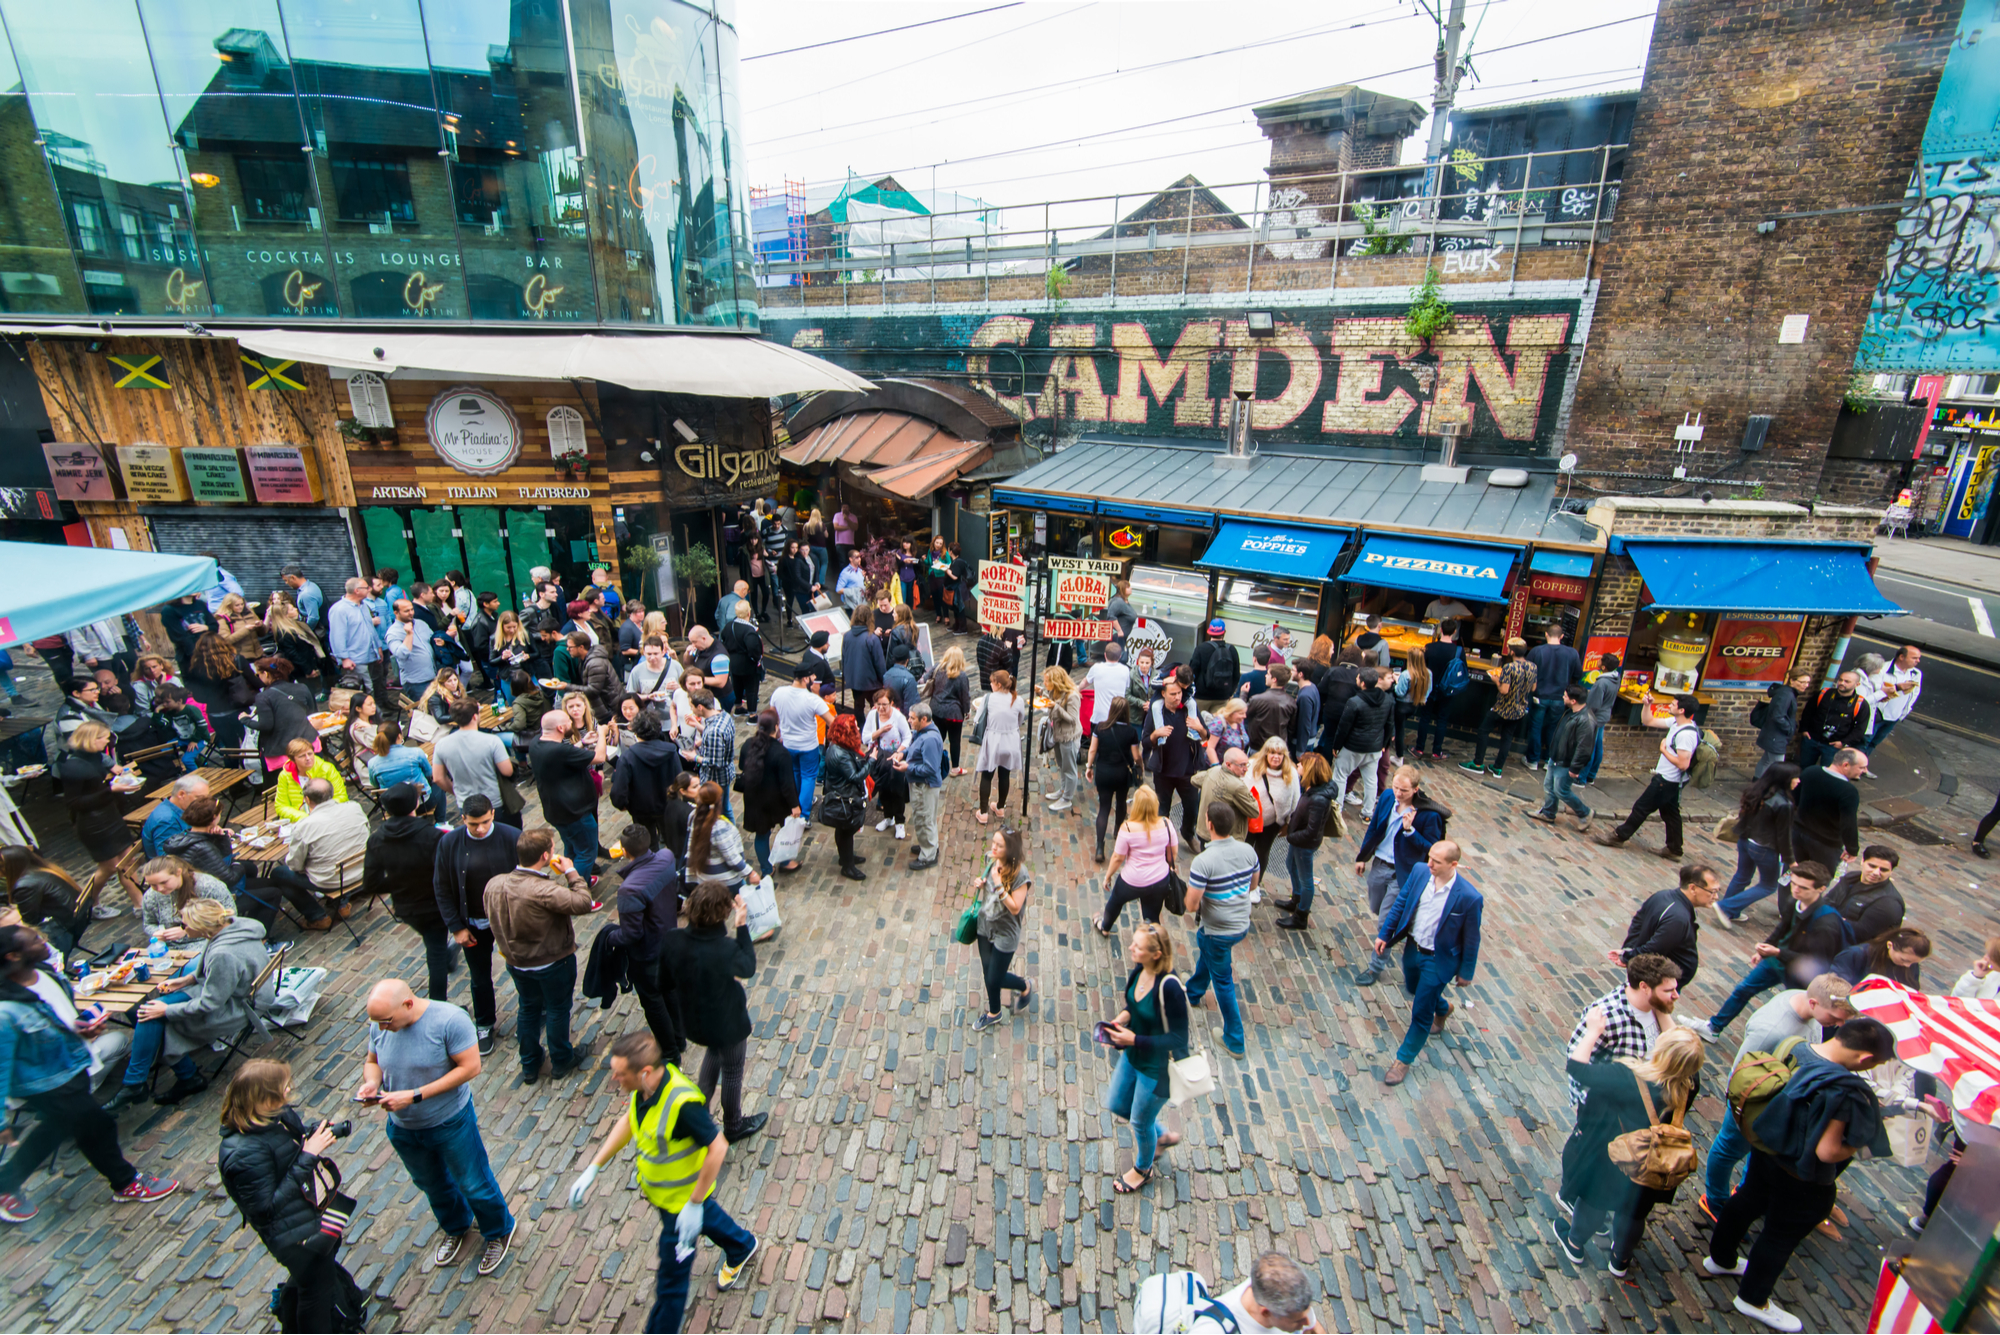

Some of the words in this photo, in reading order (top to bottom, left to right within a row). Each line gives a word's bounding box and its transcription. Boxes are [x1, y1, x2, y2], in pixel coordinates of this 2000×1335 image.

[246, 250, 355, 266] COCKTALS
[381, 253, 462, 267] LOUNGE
[525, 256, 564, 269] BAR
[522, 309, 580, 319] MARTINI
[967, 313, 1571, 441] CAMDEN
[1932, 407, 1957, 421] IFT
[444, 431, 460, 446] Mr
[459, 428, 510, 447] Piadina's
[461, 447, 493, 456] HOUSE
[1960, 448, 1991, 519] TATTOO
[372, 486, 427, 499] ARTISAN
[448, 487, 498, 499] ITALIAN
[518, 487, 590, 499] FLATBREAD
[1241, 539, 1308, 555] POPPIE'S
[1051, 557, 1083, 569] WEST
[1087, 560, 1119, 572] YARD
[1363, 552, 1499, 580] PIZZERIA
[981, 565, 1024, 586] NORTH
[987, 581, 1017, 593] YARD
[1060, 575, 1107, 600] GLOBAL
[1532, 579, 1583, 595] COFFEE
[983, 597, 1020, 612] STABLES
[1059, 593, 1106, 605] KITCHEN
[981, 607, 1022, 625] MARKET
[1725, 612, 1775, 620] ESPRESSO
[1046, 620, 1097, 638] MIDDLE
[1126, 633, 1172, 655] oppies
[1665, 641, 1704, 654] LEMONADE
[1722, 645, 1783, 657] COFFEE
